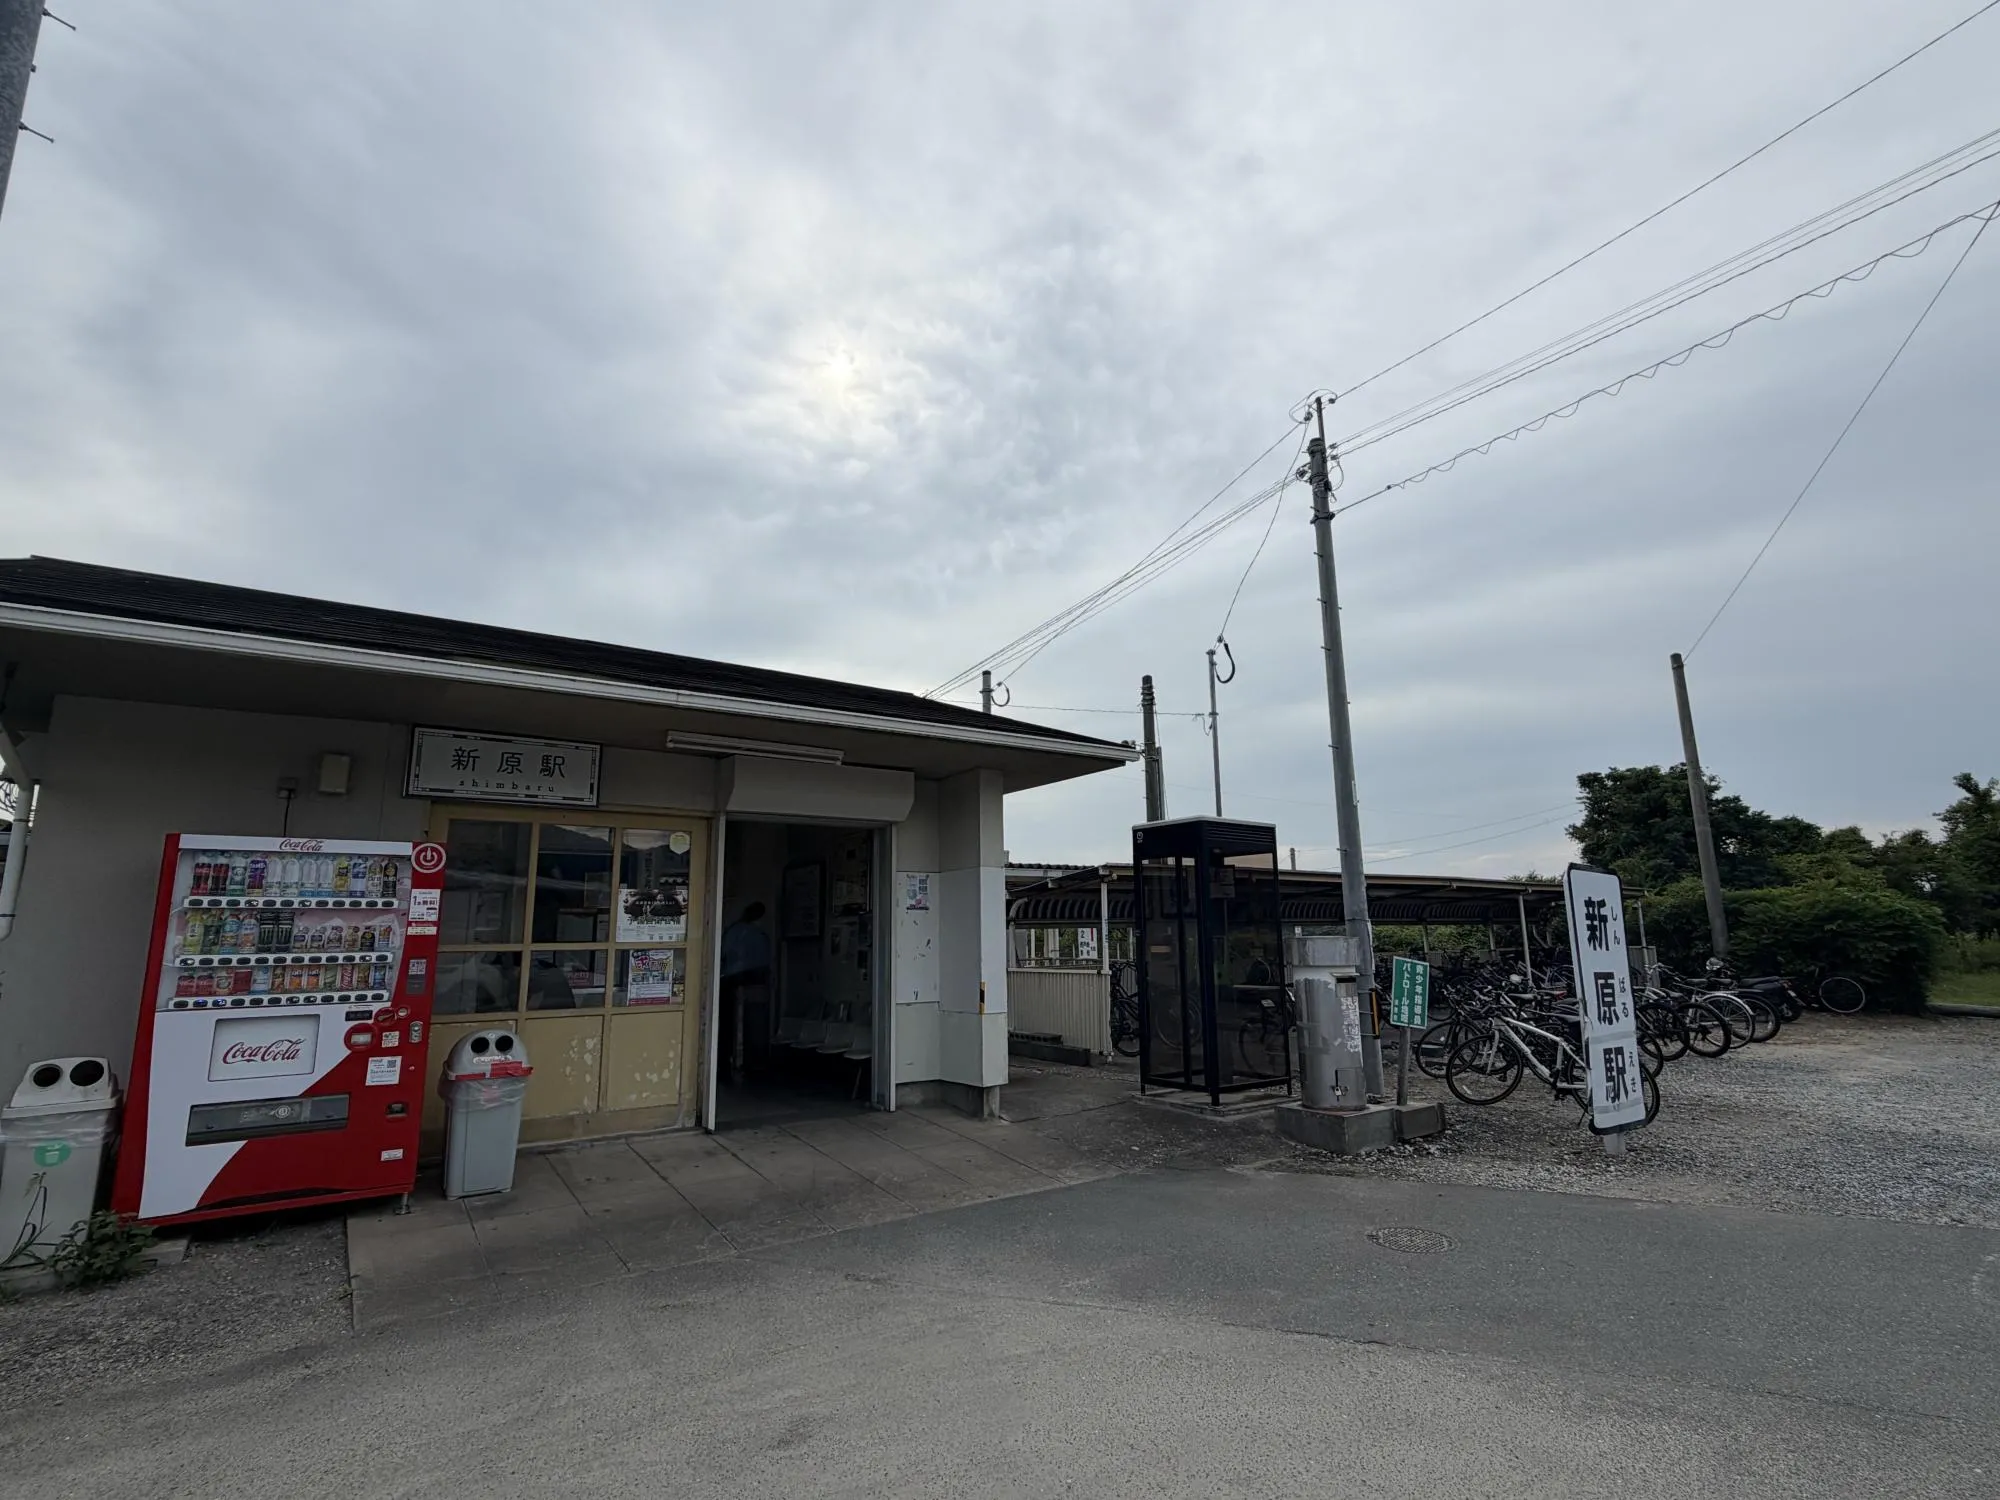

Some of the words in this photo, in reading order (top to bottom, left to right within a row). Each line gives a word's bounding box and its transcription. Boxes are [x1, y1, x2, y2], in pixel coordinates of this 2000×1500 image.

[451, 746, 566, 779] 新原駅
[459, 779, 555, 792] shimbaru
[279, 838, 328, 852] Coca-Cola
[1583, 896, 1629, 1103] 新原駅
[222, 1038, 307, 1064] Coca-Cola
